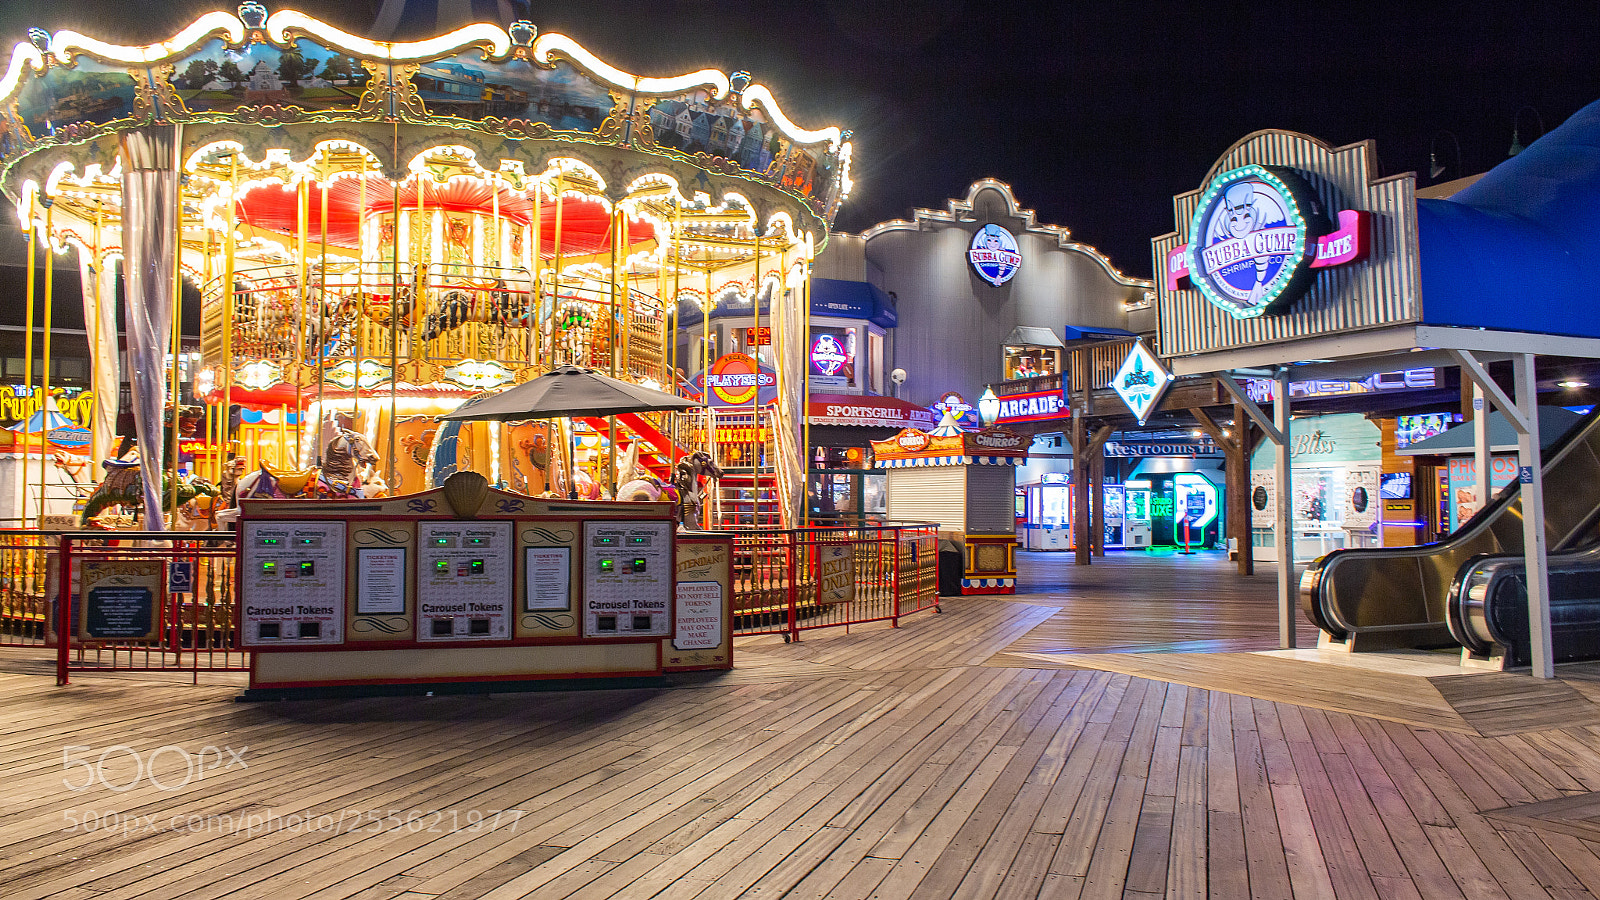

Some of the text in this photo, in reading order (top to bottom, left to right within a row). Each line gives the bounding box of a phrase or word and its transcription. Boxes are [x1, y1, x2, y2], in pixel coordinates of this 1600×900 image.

[1204, 232, 1297, 269] BUBBA GUMP
[1317, 234, 1352, 259] LATE
[972, 251, 1020, 266] BUBBA GUMP
[1221, 260, 1255, 277] SHRIMP
[1000, 395, 1059, 418] ARCADE
[899, 436, 924, 446] CHURROS
[976, 434, 1021, 448] CHURROS
[1110, 442, 1196, 455] Restrooms
[1291, 430, 1336, 459] Bliss
[1450, 457, 1516, 474] PHOS
[676, 553, 726, 574] TTENDANT
[823, 557, 850, 576] EXIT
[821, 572, 851, 592] ONLY
[247, 606, 334, 616] Carousel Tokens
[422, 603, 503, 613] Carousel Tokens
[589, 600, 665, 610] Carousel Tokens
